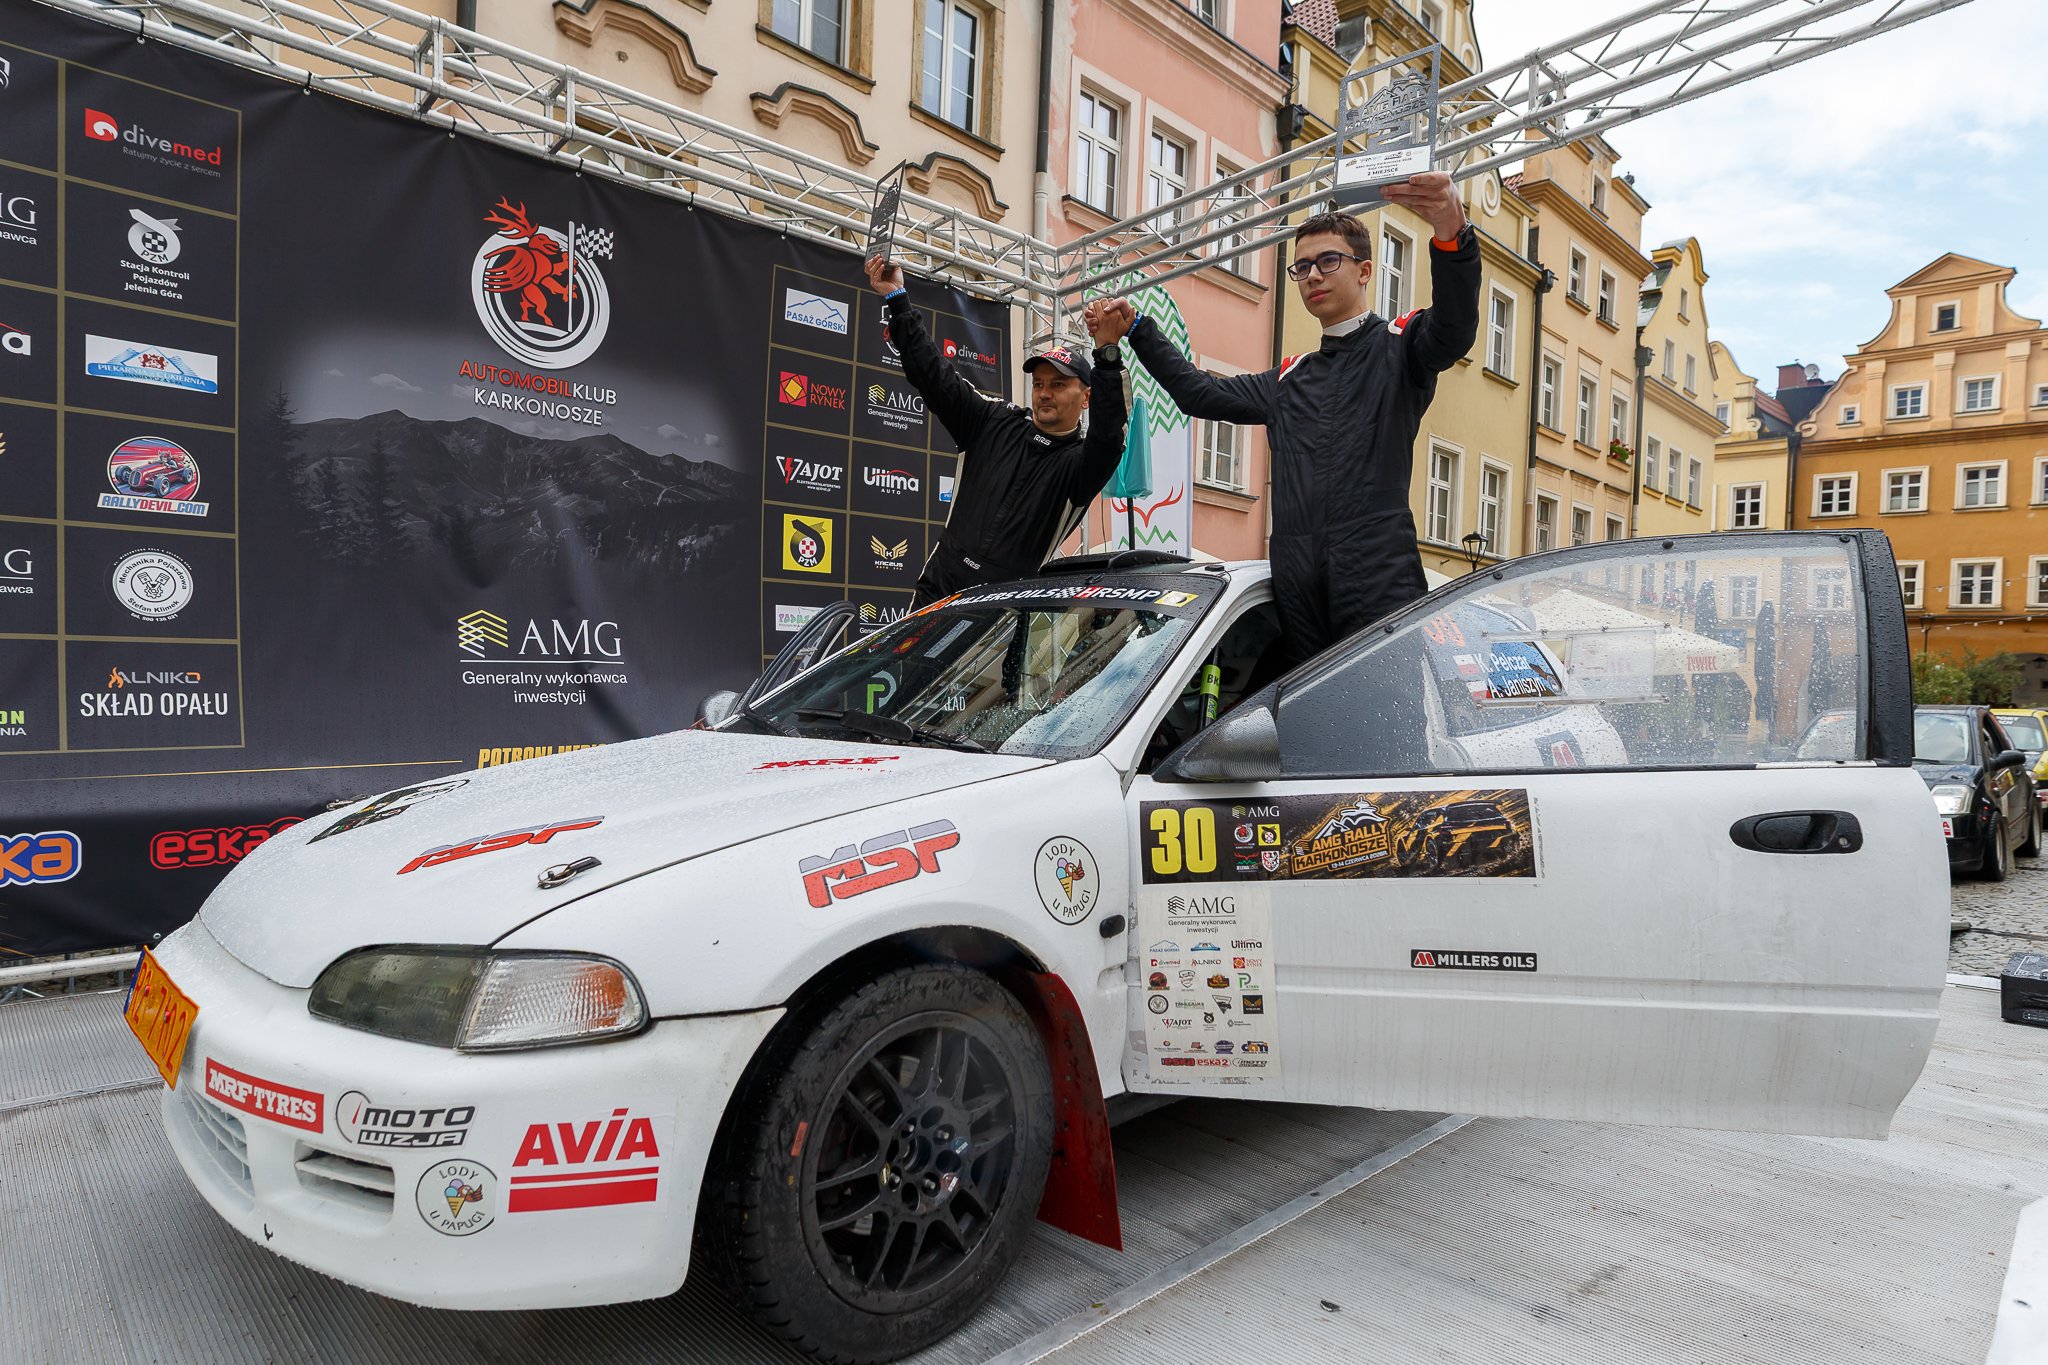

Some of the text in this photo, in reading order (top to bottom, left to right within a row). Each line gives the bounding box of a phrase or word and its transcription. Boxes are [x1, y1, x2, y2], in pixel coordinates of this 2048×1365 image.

[123, 125, 222, 166] divemed
[123, 146, 158, 163] Ratujmy
[160, 154, 182, 169] życie
[192, 164, 221, 178] sercem
[140, 250, 169, 264] PZM
[120, 259, 190, 280] Stacja Kontroli
[124, 281, 183, 300] Jelenia Góra
[133, 273, 178, 289] Pojazdów
[786, 310, 846, 332] PASAŻ GÓRSKI
[958, 345, 996, 365] divemed
[98, 364, 206, 386] PIEKARNIA CUKIERNIA
[459, 360, 617, 405] AUTOMOBILKLUB
[810, 383, 846, 396] NOWY
[474, 387, 602, 426] KARKONOSZE
[810, 395, 846, 410] RYNEK
[886, 391, 924, 412] AMG
[868, 408, 923, 425] Generalny wykonawca
[883, 419, 908, 430] inwestycji
[1034, 434, 1052, 446] RRS
[776, 456, 843, 482] WAJOT
[864, 467, 919, 492] Ultima
[102, 495, 206, 515] RALLYDEVIL.COM
[798, 556, 818, 567] PZM
[963, 557, 980, 570] RRS
[119, 558, 188, 590] Mechanika Pojazdowa
[127, 598, 180, 612] Stefan Klimek
[946, 586, 1162, 608] MILLERS OILS HRSMP
[879, 607, 906, 622] AM
[518, 618, 621, 657] AMG
[1491, 652, 1531, 671] Pelczar
[109, 668, 201, 688] ALNIKO
[462, 670, 628, 686] Generalny wykonawca
[1488, 676, 1546, 698] A. Janiszyn
[80, 692, 228, 717] SKŁAD OPAŁU
[514, 690, 586, 705] inwestycji
[752, 756, 900, 770] MRF
[1248, 806, 1280, 818] AMG
[1150, 807, 1217, 874] 30
[1312, 821, 1388, 852] AMG RALLY
[1046, 842, 1076, 862] LODY
[1296, 837, 1386, 870] KARKONOSZE
[798, 818, 960, 909] MSP
[1053, 889, 1092, 918] U PAPUGI
[1187, 896, 1235, 914] AMG
[1231, 940, 1262, 949] Ultima
[1438, 954, 1534, 968] MILLERS OILS
[209, 1068, 316, 1124] MRF TYRES
[362, 1106, 475, 1128] MOTO
[358, 1129, 466, 1146] WIZJA
[439, 1166, 480, 1182] LODY
[430, 1210, 485, 1231] U PAPUGI
